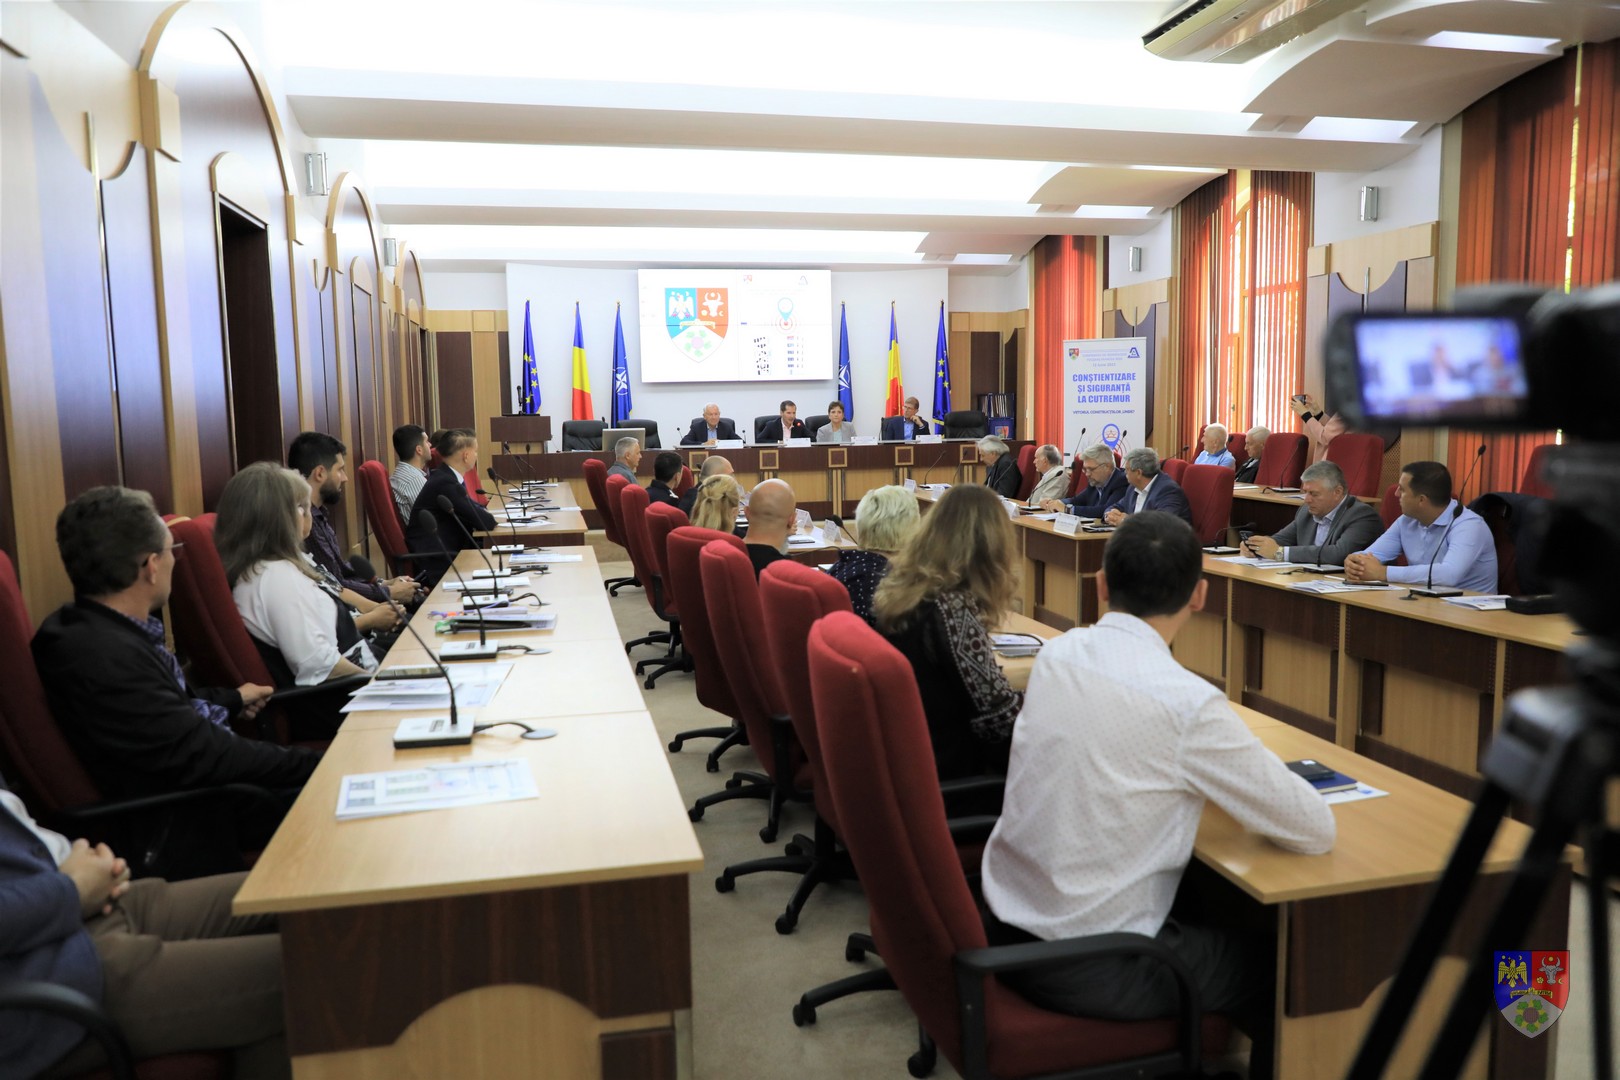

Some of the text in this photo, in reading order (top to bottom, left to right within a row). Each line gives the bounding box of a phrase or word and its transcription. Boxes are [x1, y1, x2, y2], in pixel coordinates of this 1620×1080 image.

[1072, 373, 1136, 383] CONȘTIENTIZARE
[1077, 383, 1131, 394] ȘI SIGURANȚĂ
[1077, 394, 1131, 403] LA CUTREMUR
